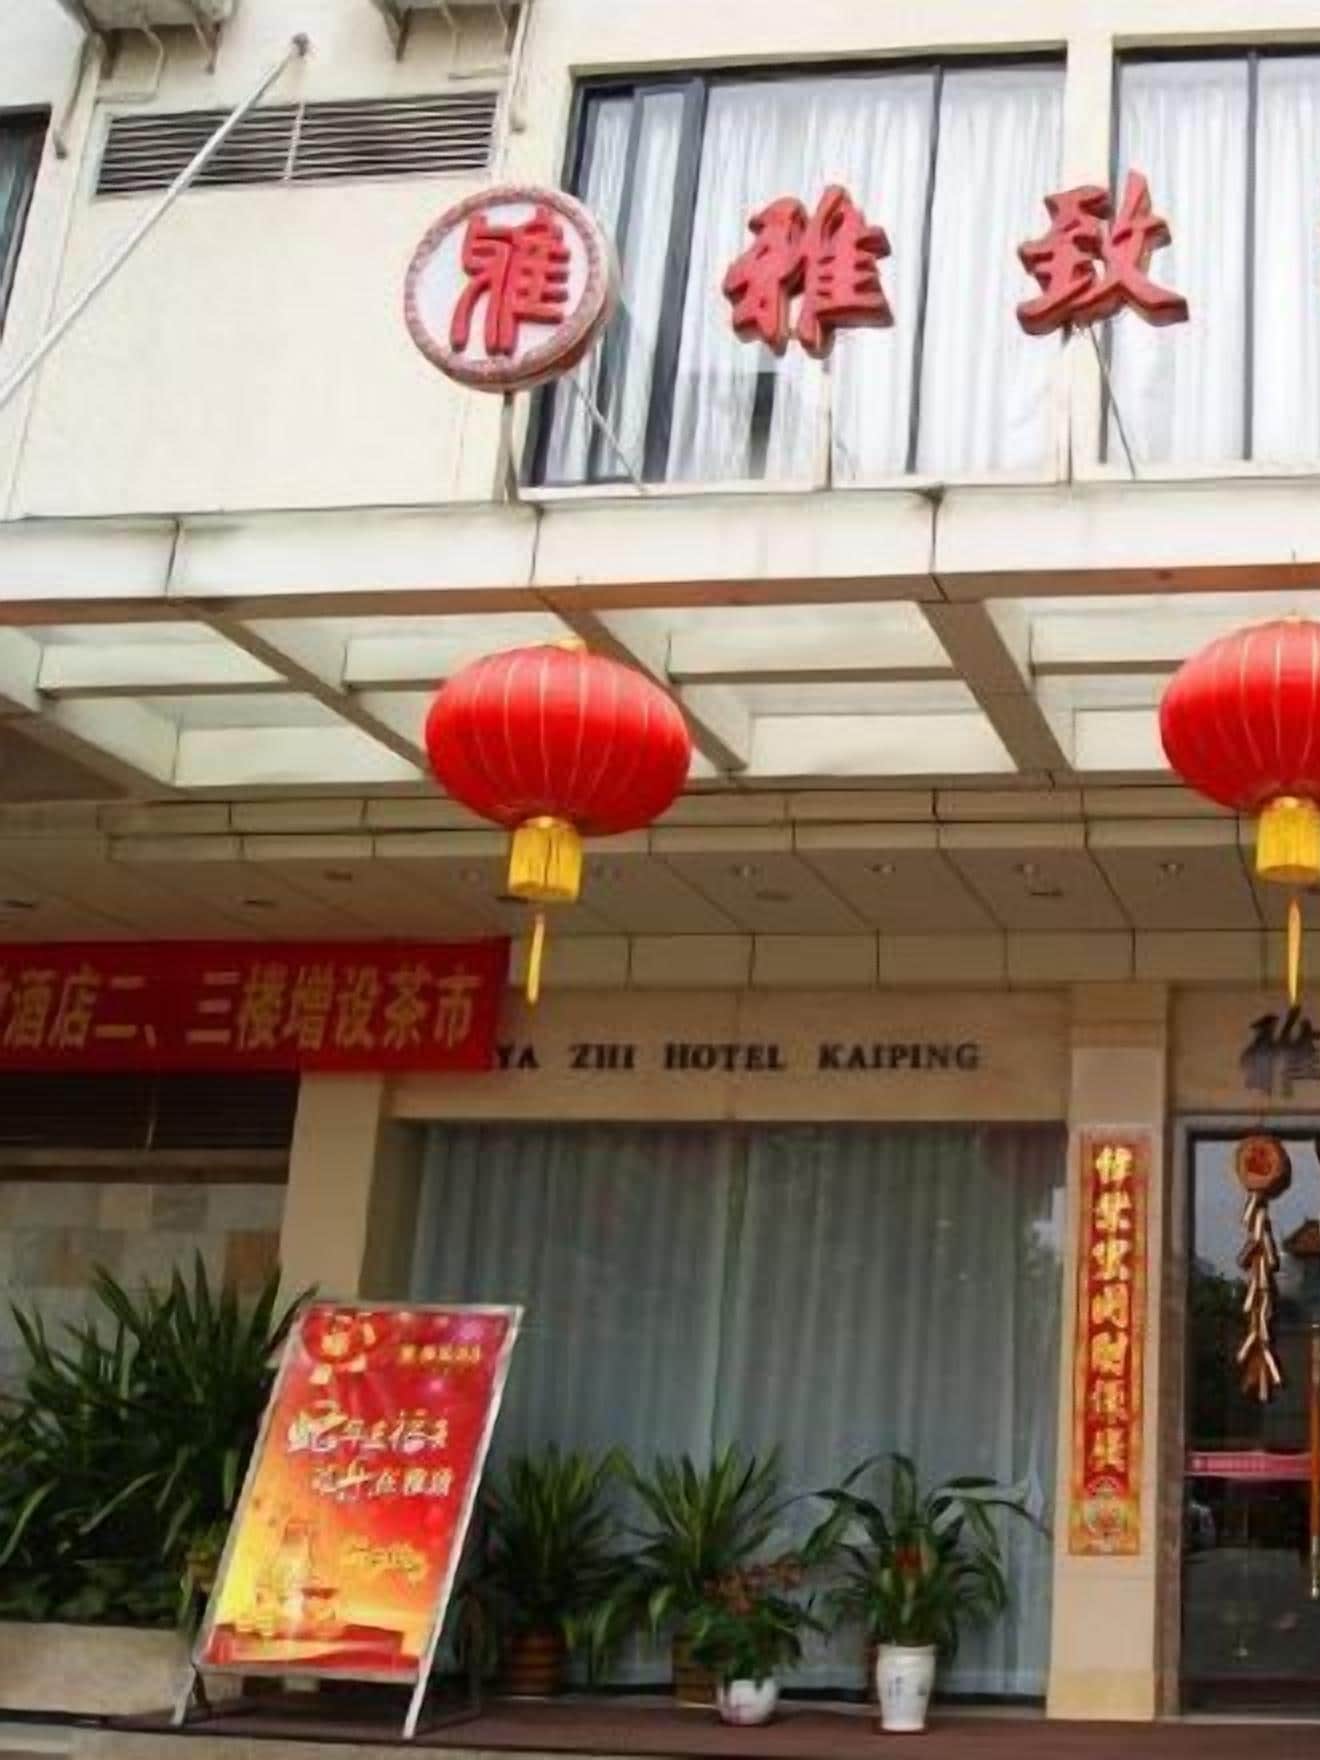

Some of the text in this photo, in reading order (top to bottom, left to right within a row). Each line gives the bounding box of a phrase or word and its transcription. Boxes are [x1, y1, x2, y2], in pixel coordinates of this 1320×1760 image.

[0, 963, 482, 1051] 酒店二、三楼增设茶市
[494, 1043, 981, 1071] YA ZHI HOTEL KAIPING
